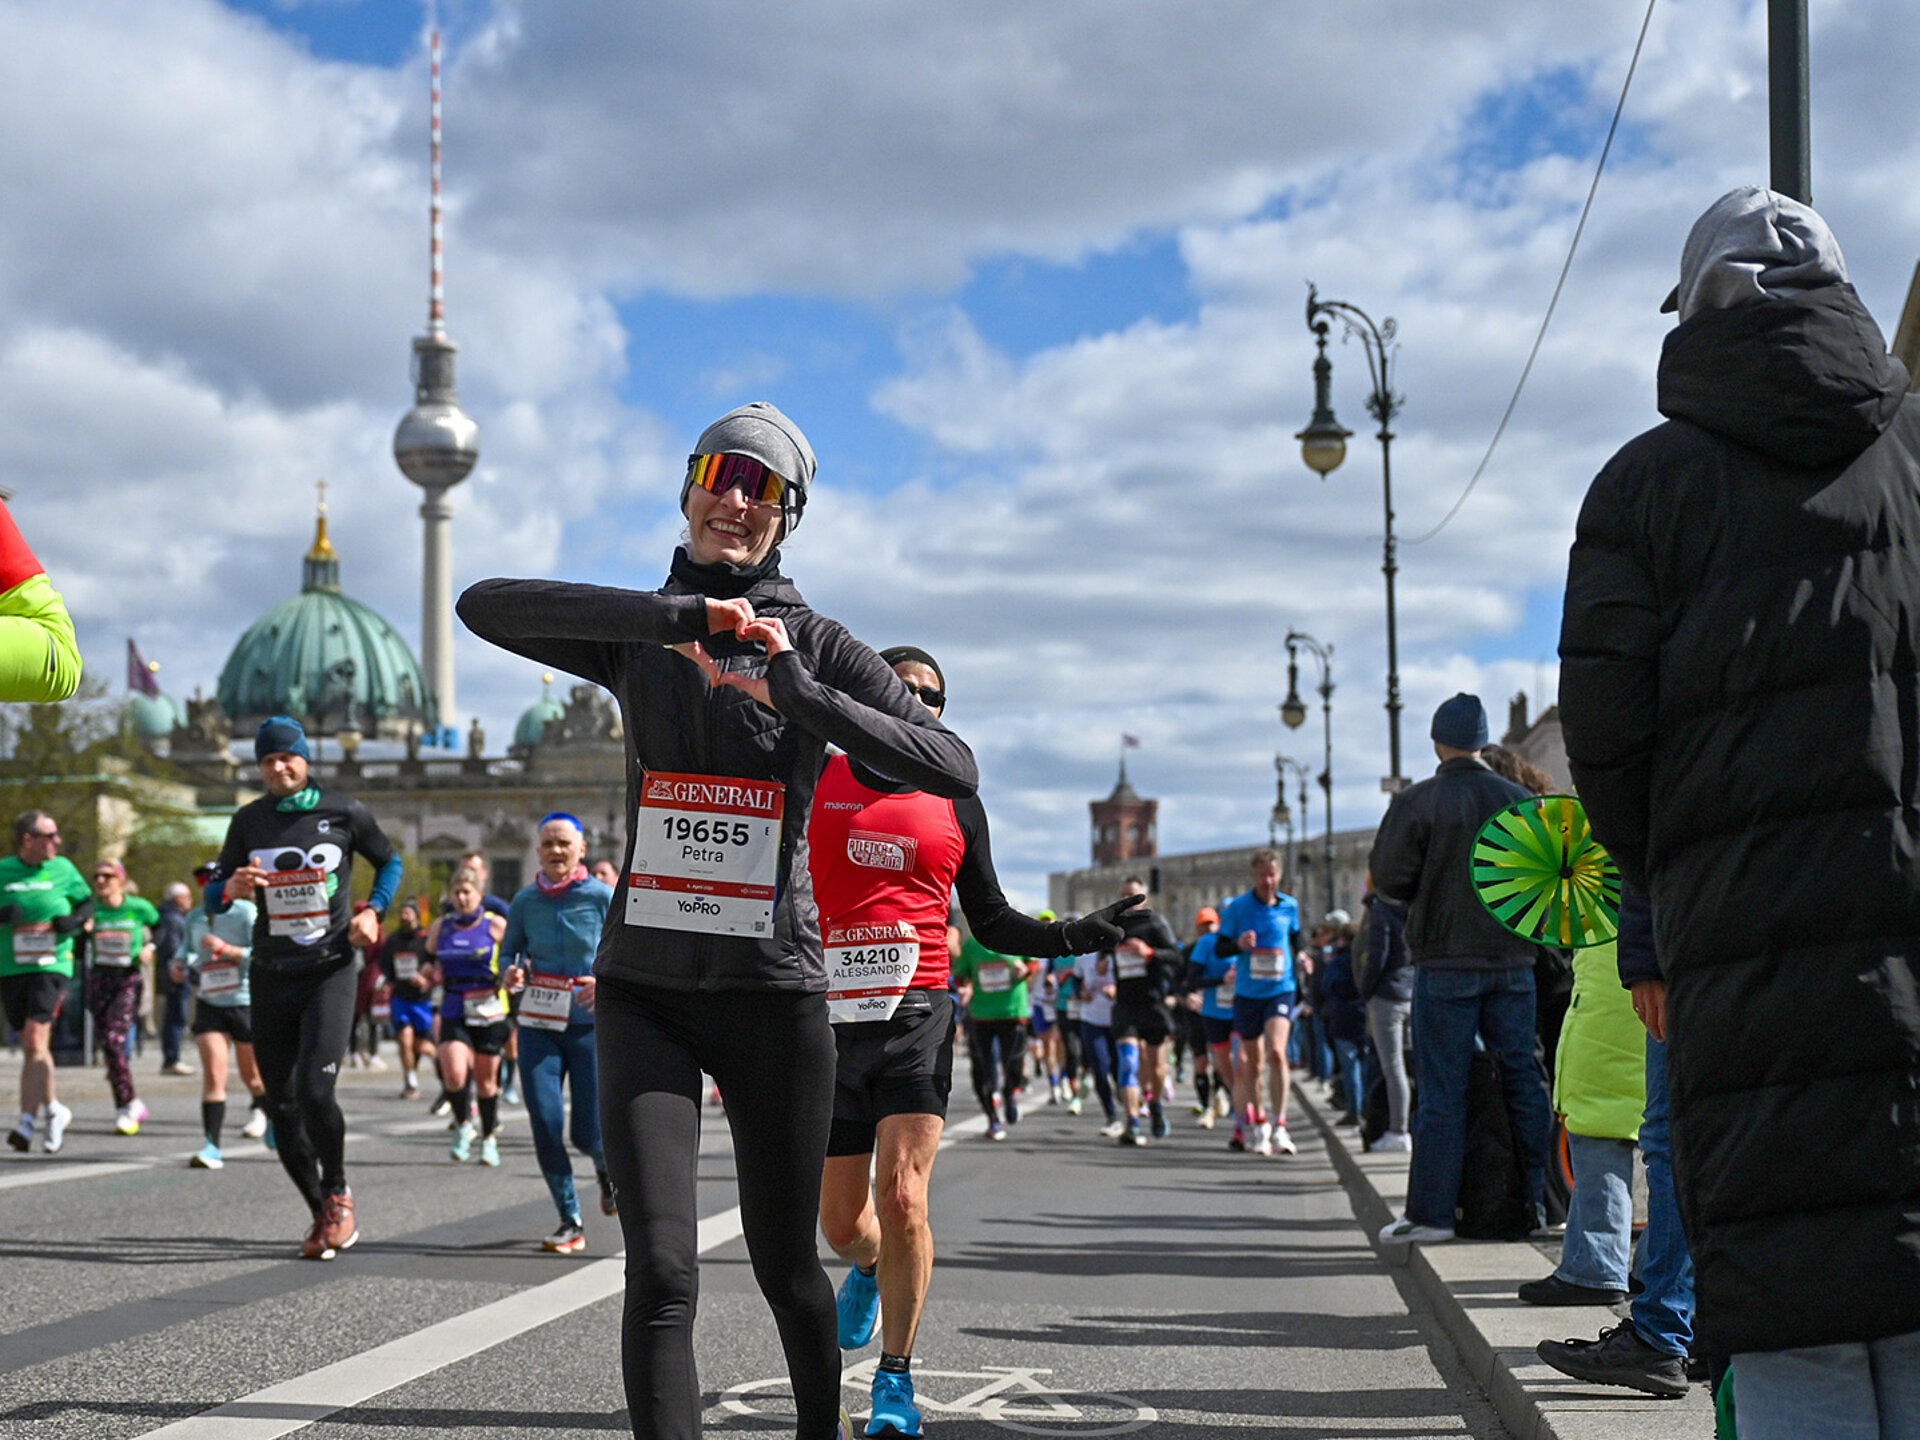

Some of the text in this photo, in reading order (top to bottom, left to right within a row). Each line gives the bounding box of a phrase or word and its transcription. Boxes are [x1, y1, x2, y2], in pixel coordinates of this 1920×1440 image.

[673, 782, 774, 810] GENERALI
[823, 802, 864, 811] macron
[663, 816, 749, 846] 19655
[681, 845, 724, 863] Petra
[274, 885, 316, 899] 41040
[677, 899, 721, 916] YoPRO
[841, 947, 900, 966] 34210
[833, 964, 910, 978] ALESSANDRO
[857, 1000, 887, 1011] YoPRO
